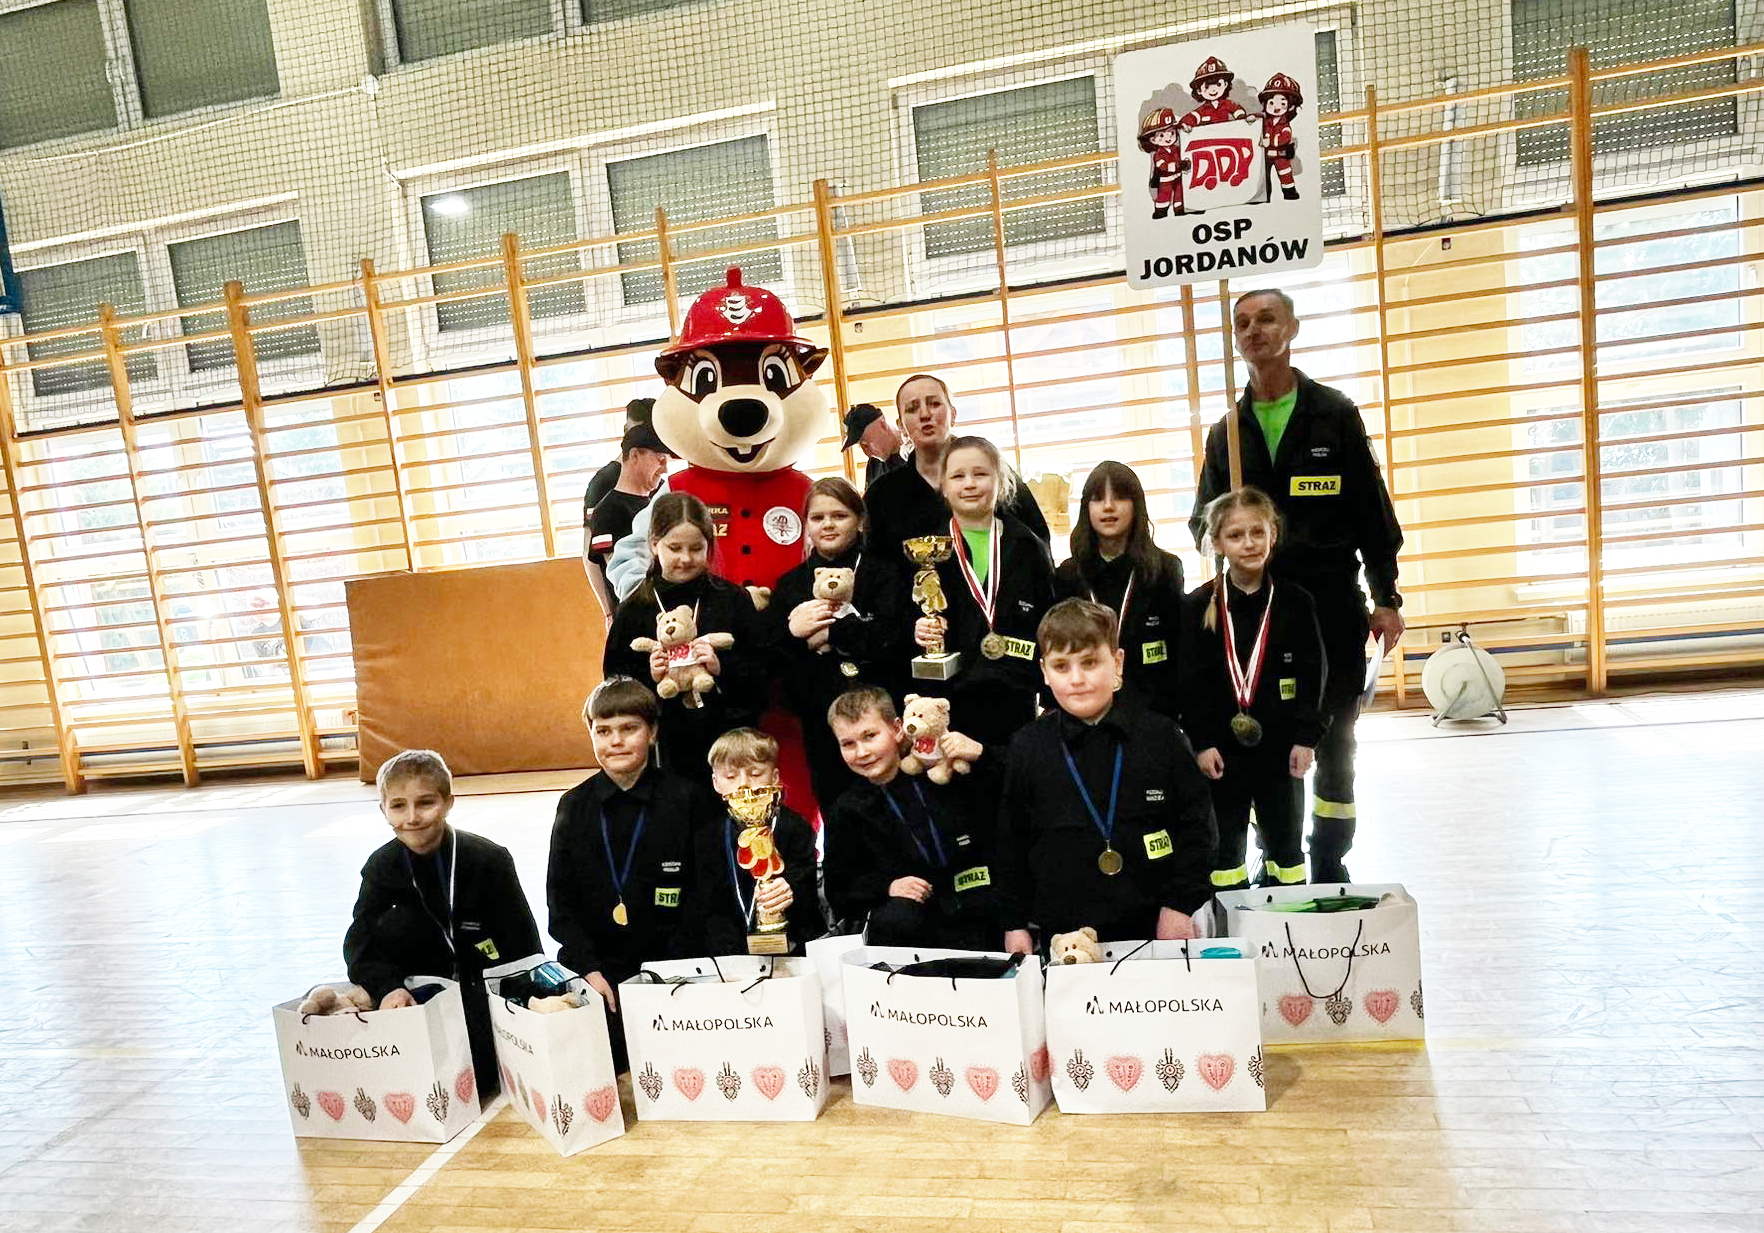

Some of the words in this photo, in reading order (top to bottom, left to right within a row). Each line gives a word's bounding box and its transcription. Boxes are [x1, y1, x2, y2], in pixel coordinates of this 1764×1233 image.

[1192, 218, 1253, 245] OSP
[1140, 236, 1309, 280] JORDANÓW
[1283, 942, 1391, 960] MAŁOPOLSKA
[1108, 998, 1222, 1014] MAŁOPOLSKA
[672, 1016, 774, 1031] MAŁOPOLSKA
[890, 1008, 988, 1028] MAŁOPOLSKA
[309, 1043, 400, 1060] MAŁOPOLSKA
